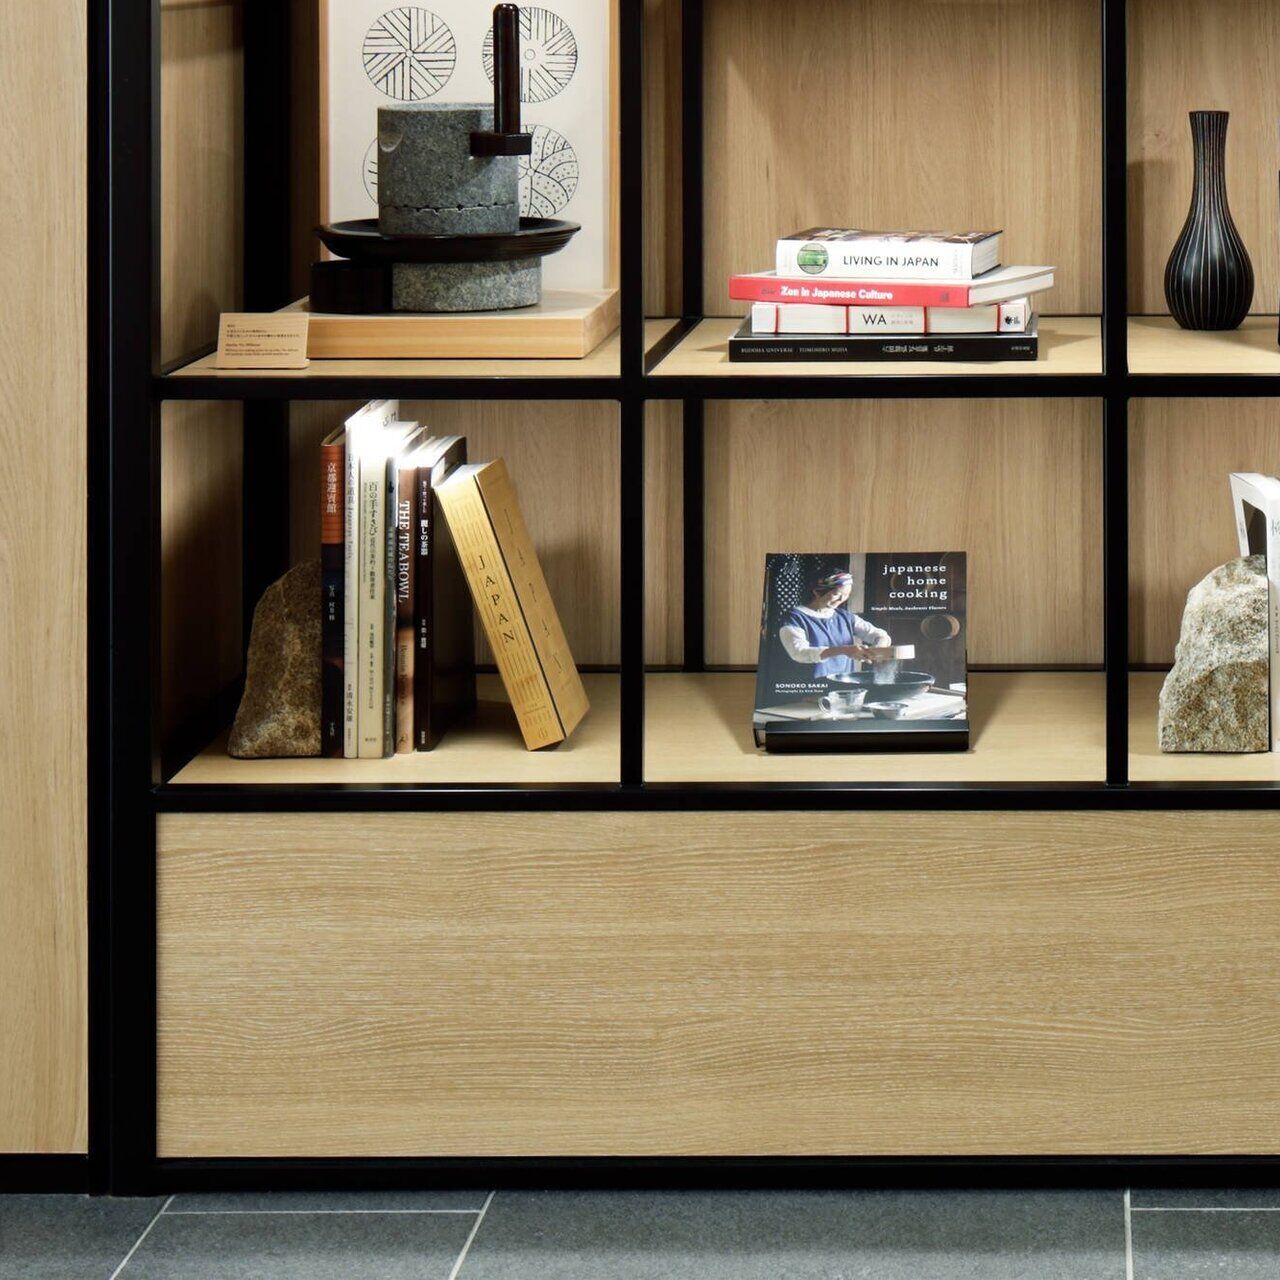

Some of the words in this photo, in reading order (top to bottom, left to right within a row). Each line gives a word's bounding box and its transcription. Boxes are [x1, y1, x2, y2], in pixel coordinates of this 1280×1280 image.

[843, 256, 883, 267] LIVING
[886, 256, 899, 267] IN
[902, 256, 939, 267] JAPAN
[781, 287, 798, 297] Zen
[801, 288, 810, 297] in
[812, 288, 857, 301] Japanese
[858, 289, 893, 300] Culture
[862, 314, 887, 326] WA
[399, 500, 410, 530] THE
[398, 533, 410, 603] TEABOWL
[882, 564, 947, 576] japanese
[907, 576, 947, 586] home
[479, 555, 515, 643] JAPAN
[889, 589, 948, 601] cooking
